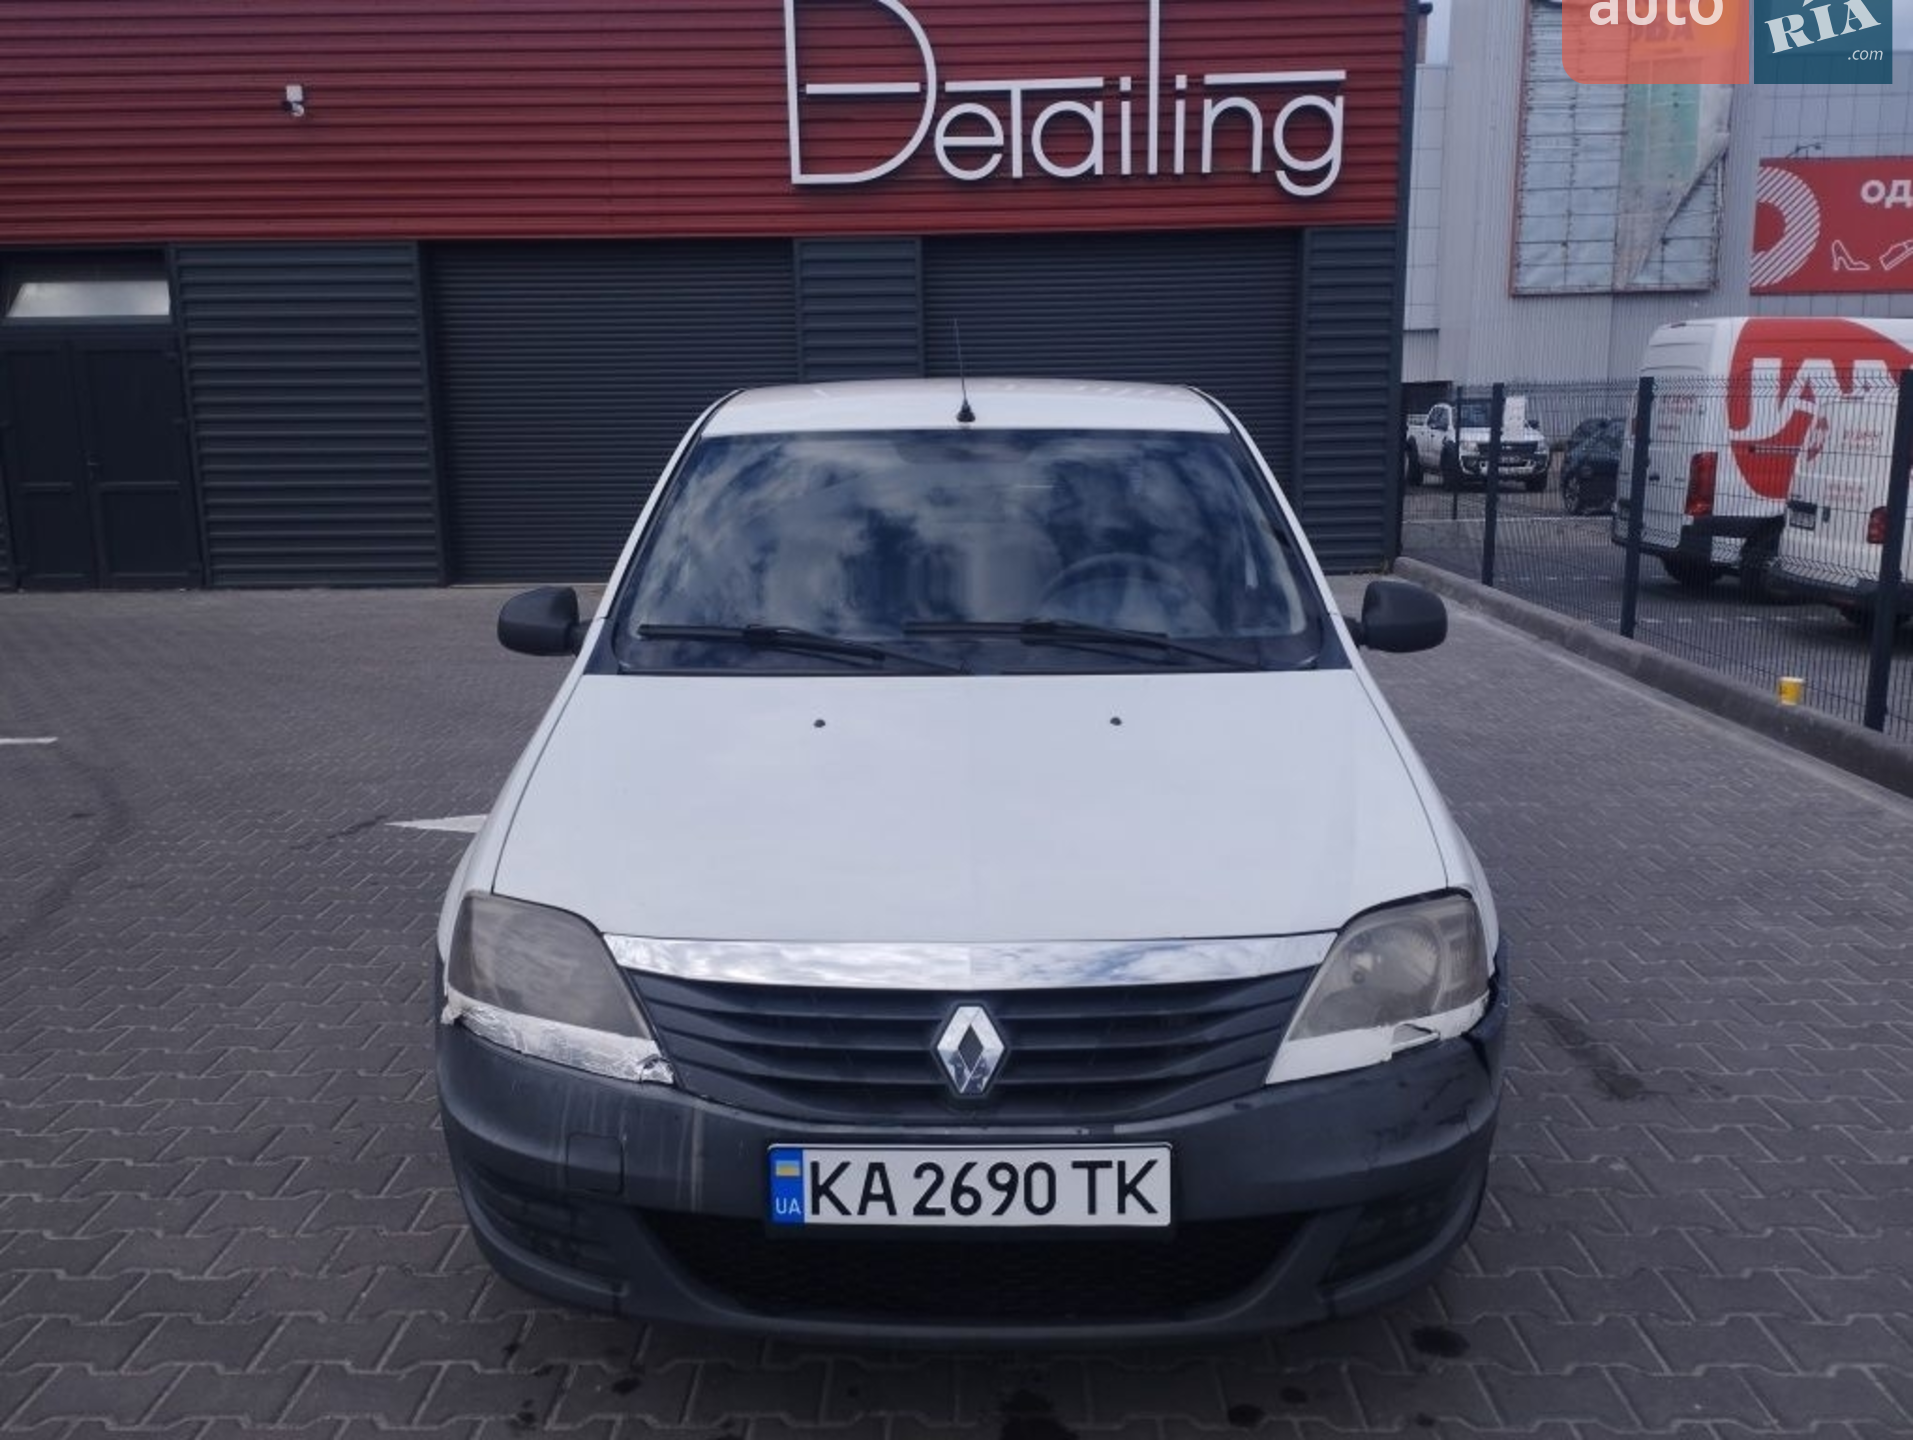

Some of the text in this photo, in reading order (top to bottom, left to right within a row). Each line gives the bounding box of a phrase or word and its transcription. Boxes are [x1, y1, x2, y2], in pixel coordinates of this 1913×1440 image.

[810, 1159, 1159, 1216] KA 2690 TK
[775, 1198, 801, 1215] UA
